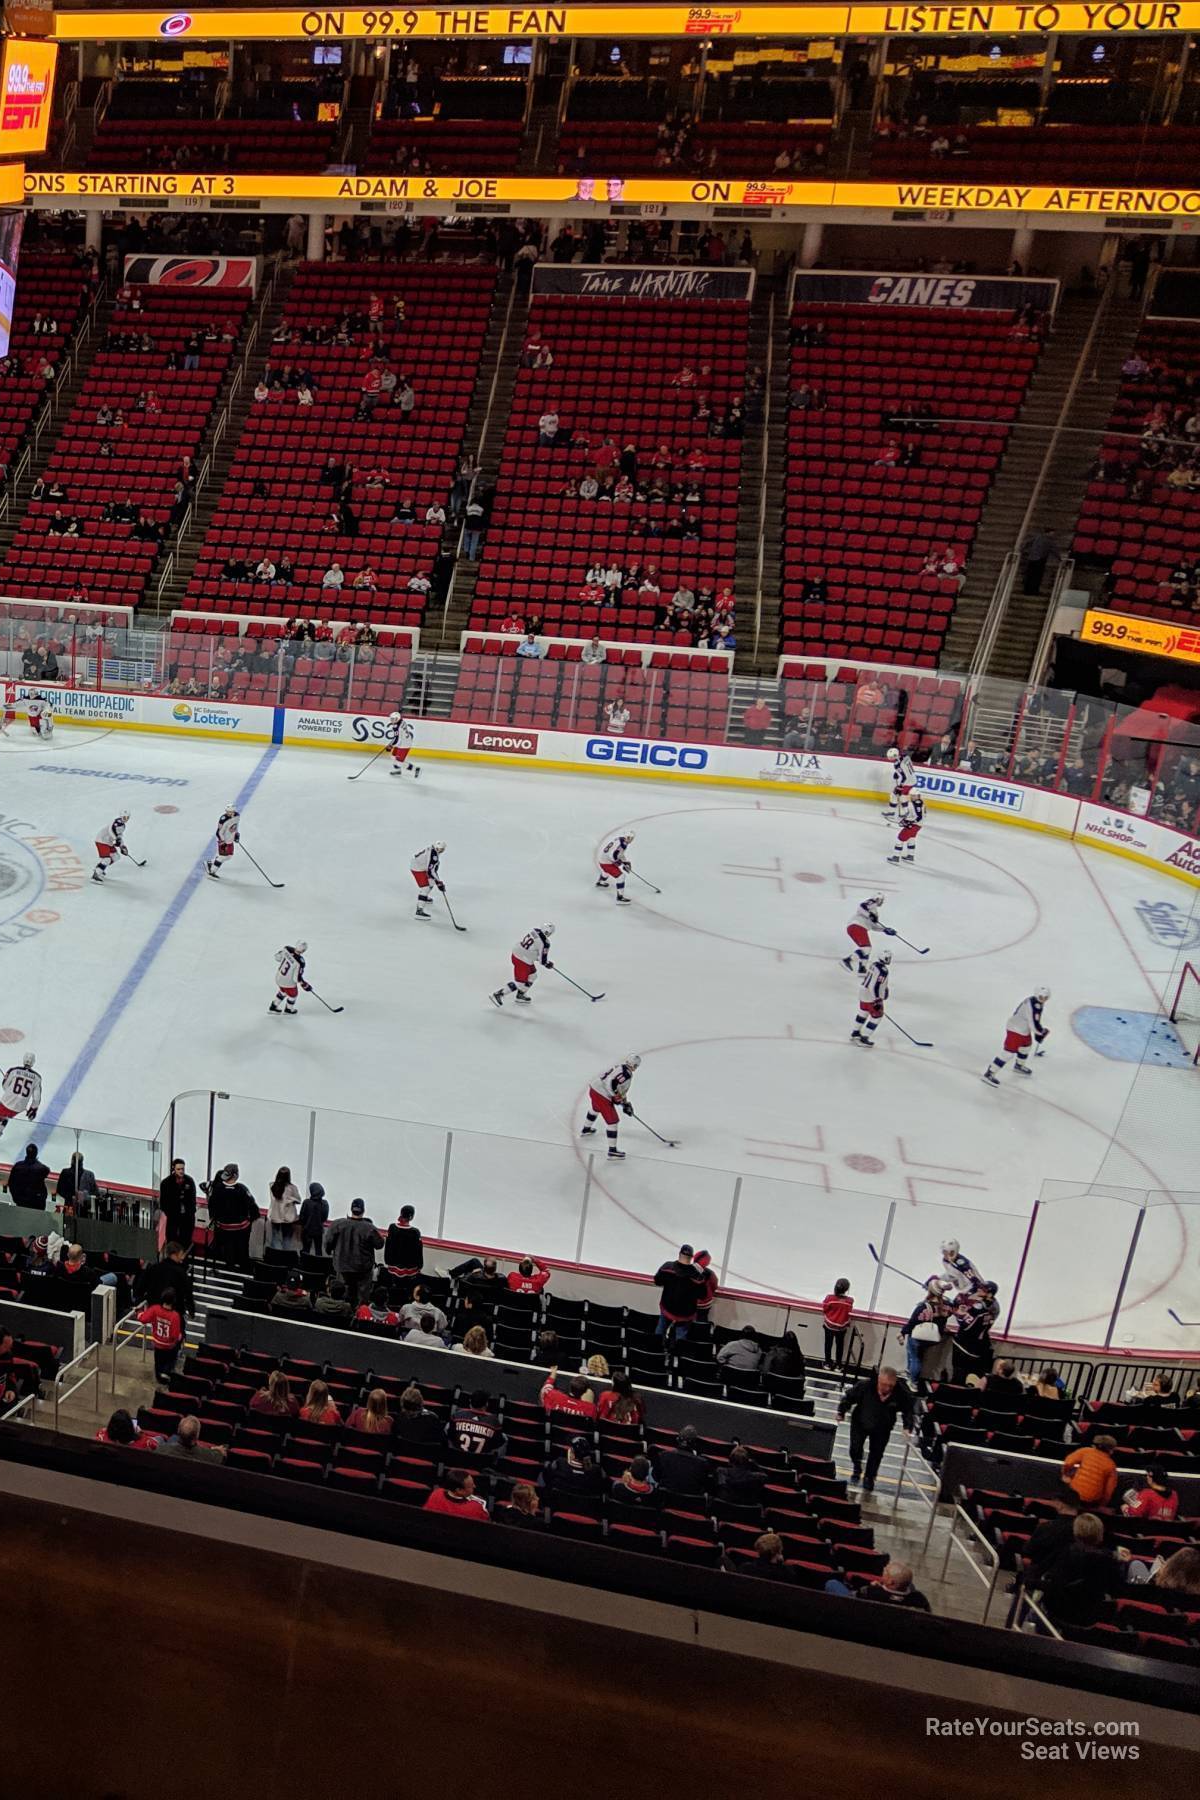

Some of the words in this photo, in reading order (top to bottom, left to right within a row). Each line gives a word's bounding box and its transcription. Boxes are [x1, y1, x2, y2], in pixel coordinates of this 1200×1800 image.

[301, 11, 344, 35] ON
[362, 11, 418, 35] 99.9
[436, 11, 490, 34] THE
[508, 10, 567, 34] FAN
[688, 8, 711, 20] 99.9
[884, 5, 991, 31] LISTEN
[1016, 4, 1060, 30] TO
[1084, 3, 1181, 29] YOUR
[7, 64, 28, 93] 99.9
[78, 175, 177, 194] STARTING
[191, 177, 218, 195] AT
[223, 178, 235, 195] 3
[338, 178, 408, 197] ADAM
[423, 179, 439, 197] &
[453, 179, 497, 198] JOE
[691, 182, 730, 202] ON
[898, 186, 1032, 208] WEEKDAY
[580, 271, 623, 293] TAKE
[631, 270, 716, 298] WARNING
[868, 277, 976, 306] CANES
[1091, 620, 1128, 639] 99.9
[64, 692, 135, 713] ORTHOPAEDIC
[64, 709, 85, 717] TEAM
[88, 711, 124, 720] DOCTORS
[193, 713, 240, 729] Lottery
[298, 717, 343, 728] ANALYTICS
[297, 724, 332, 733] POWERED
[473, 732, 533, 750] Lenovo
[586, 739, 708, 770] GEICO
[775, 752, 822, 769] DNA
[30, 764, 190, 787] ticketmaster
[914, 774, 956, 794] BUD
[958, 783, 1020, 807] LIGHT
[1084, 822, 1148, 849] NHLSHOP.com
[32, 835, 85, 893] ARENA
[279, 958, 291, 976] 13
[13, 1077, 33, 1097] 65
[459, 1433, 486, 1454] 37
